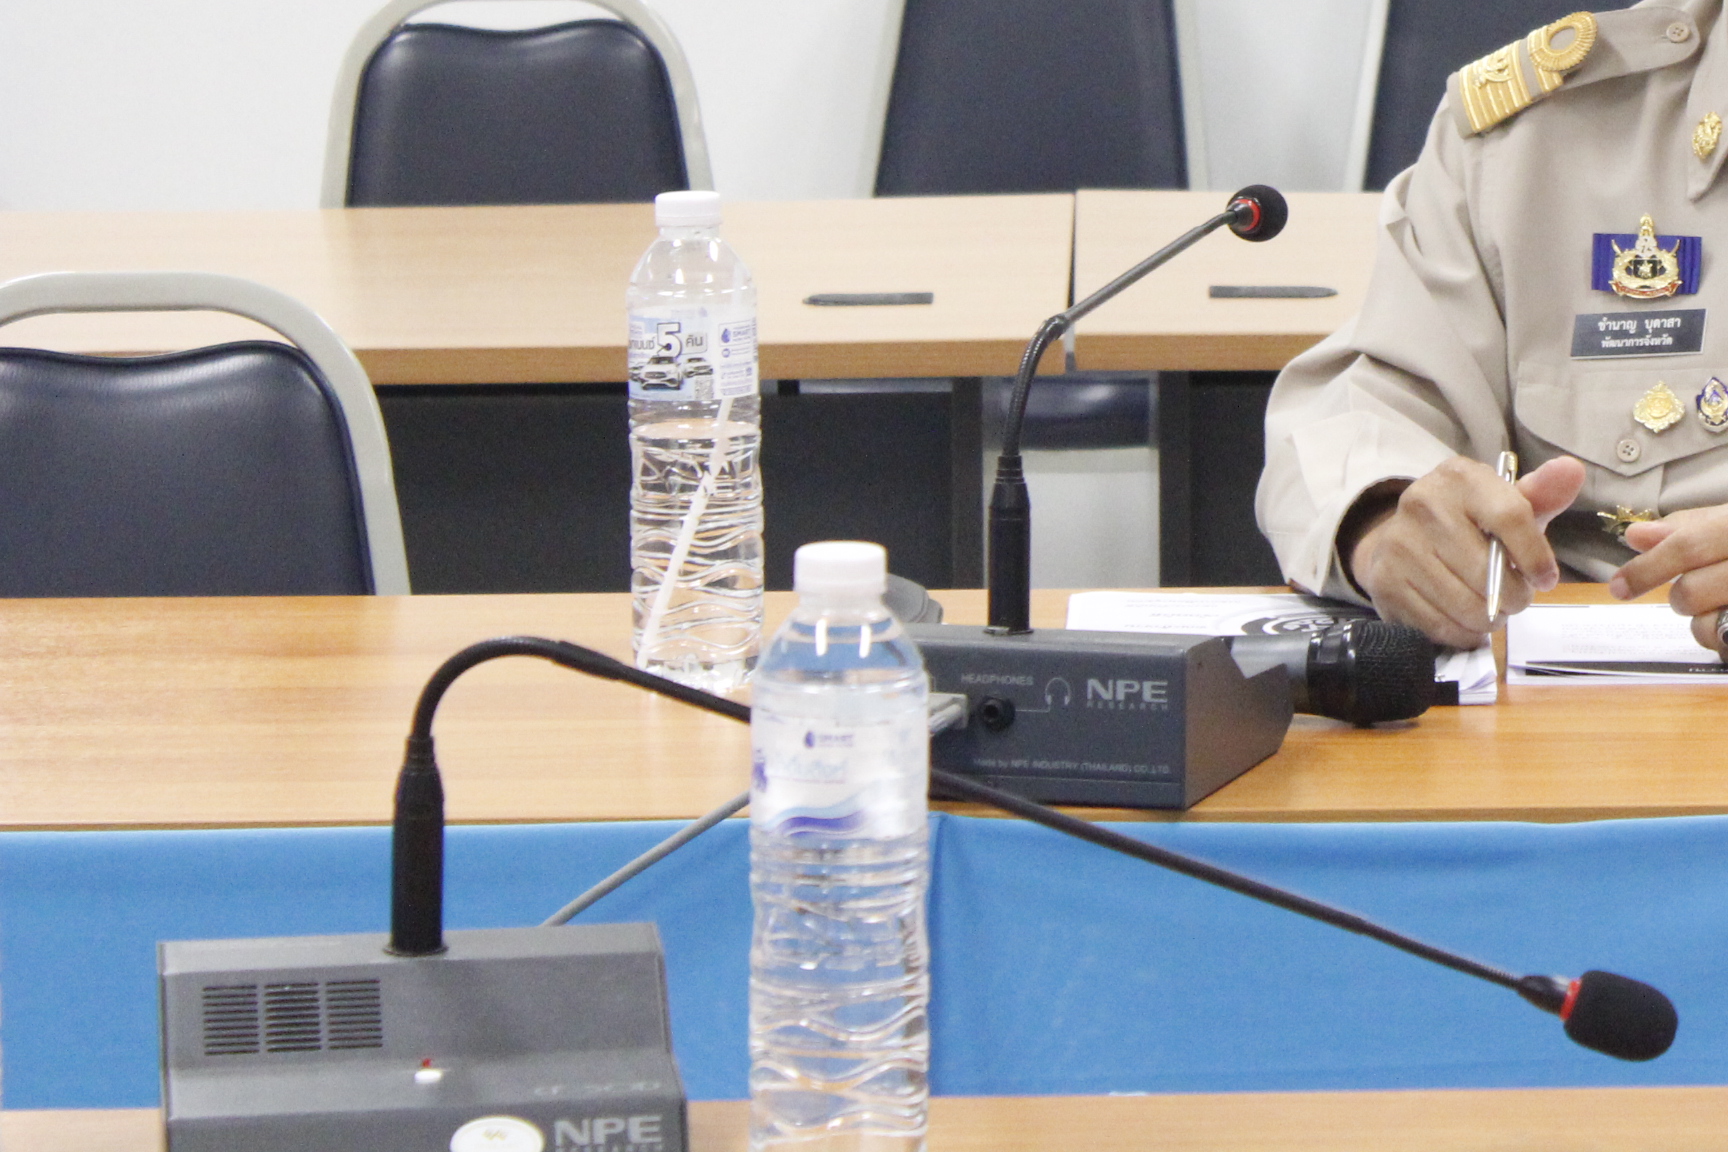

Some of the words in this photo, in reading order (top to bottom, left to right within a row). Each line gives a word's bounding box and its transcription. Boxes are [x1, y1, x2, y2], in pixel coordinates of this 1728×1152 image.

[656, 322, 682, 359] 5
[685, 334, 704, 347] คัน
[961, 673, 1034, 686] HEADPHONES
[1086, 678, 1169, 703] NPE
[553, 1115, 663, 1146] NPE
